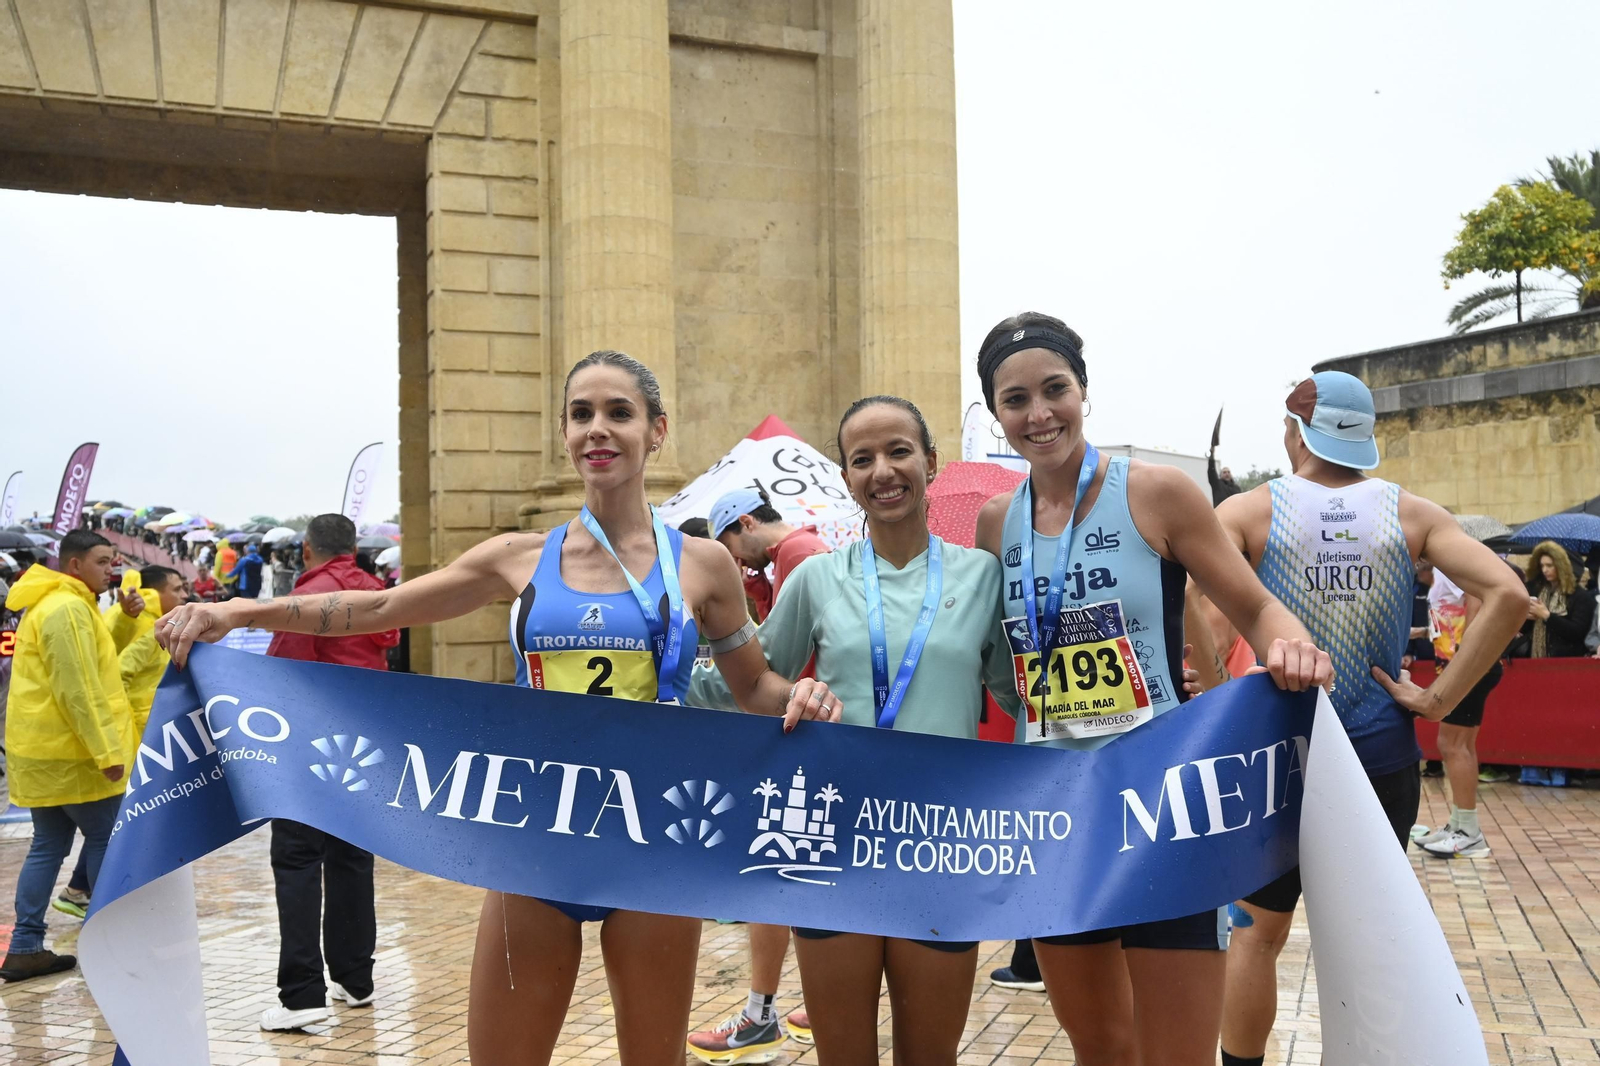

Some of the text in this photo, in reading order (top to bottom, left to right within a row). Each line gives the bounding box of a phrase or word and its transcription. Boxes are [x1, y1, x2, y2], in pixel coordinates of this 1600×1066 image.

[56, 464, 85, 536] IMDECO
[350, 469, 367, 520] DECO
[1316, 551, 1361, 564] Atletismo
[1305, 565, 1373, 592] SURCO
[1322, 592, 1356, 604] Lucena
[533, 635, 647, 651] TROTASIERRA
[586, 656, 613, 696] 2
[1028, 648, 1124, 698] 2193
[1128, 662, 1141, 690] CAJÓN
[1046, 698, 1115, 714] MARÍA DEL MAR
[1094, 714, 1134, 727] IMDECO
[125, 773, 208, 822] Municipal
[388, 743, 649, 845] META
[1119, 735, 1309, 853] META
[854, 797, 1072, 840] AYUNTAMIENTO
[852, 834, 1037, 876] DE CÓRDOBA
